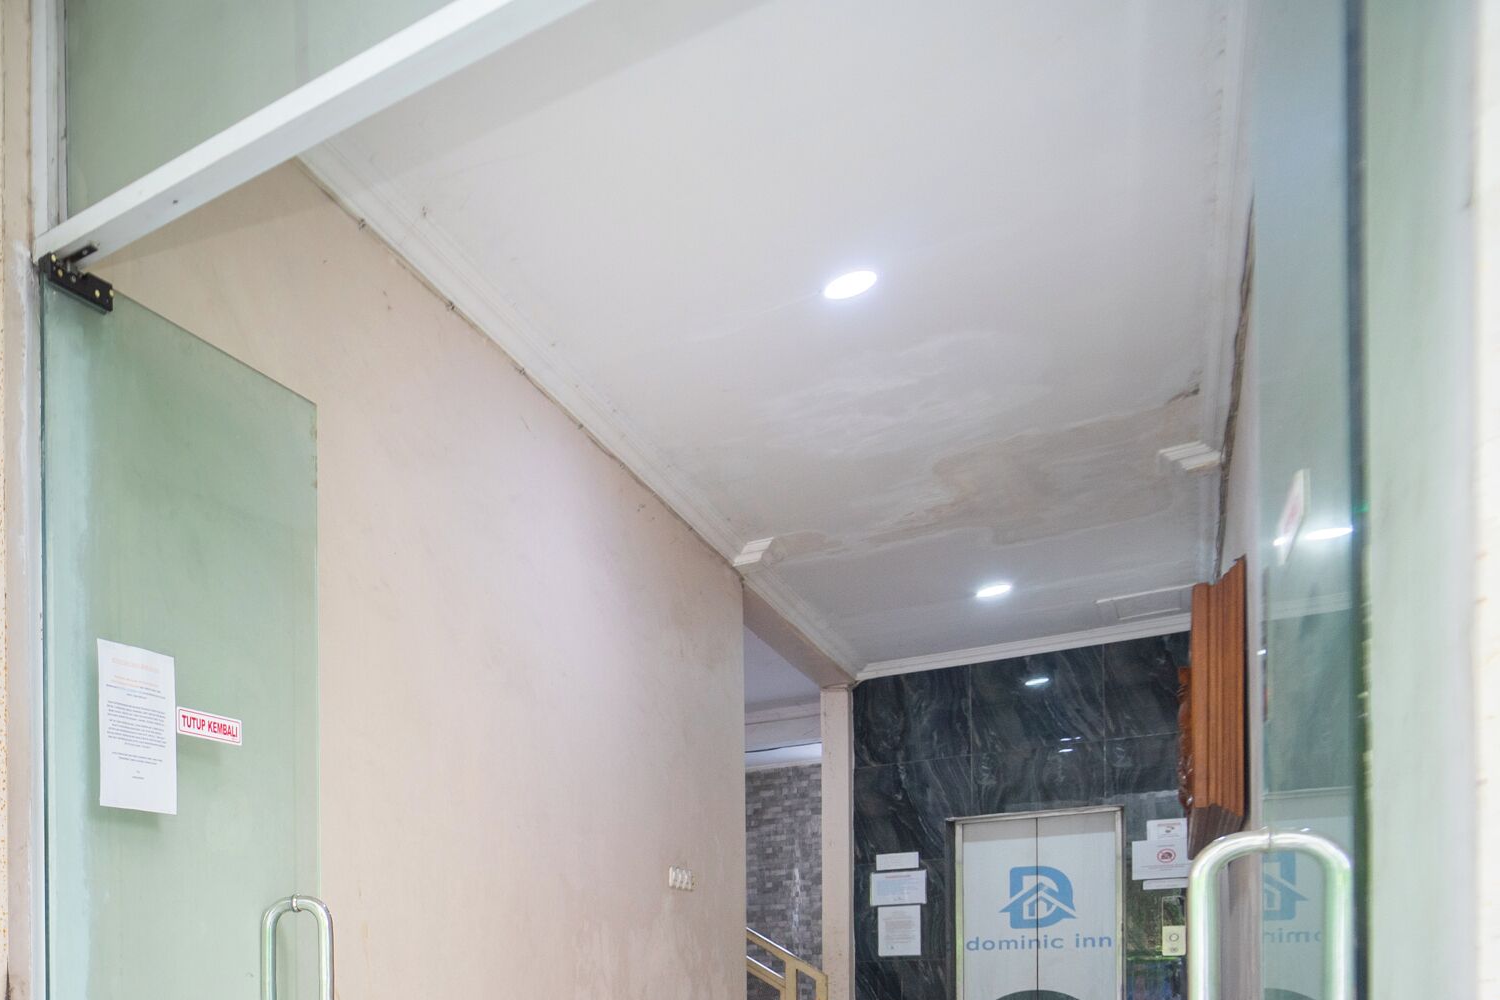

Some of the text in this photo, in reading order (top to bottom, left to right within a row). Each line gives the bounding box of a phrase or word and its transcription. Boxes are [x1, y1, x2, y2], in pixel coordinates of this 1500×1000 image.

[182, 714, 238, 738] TUTUP KEMBALI
[966, 933, 1112, 951] dominic inn
